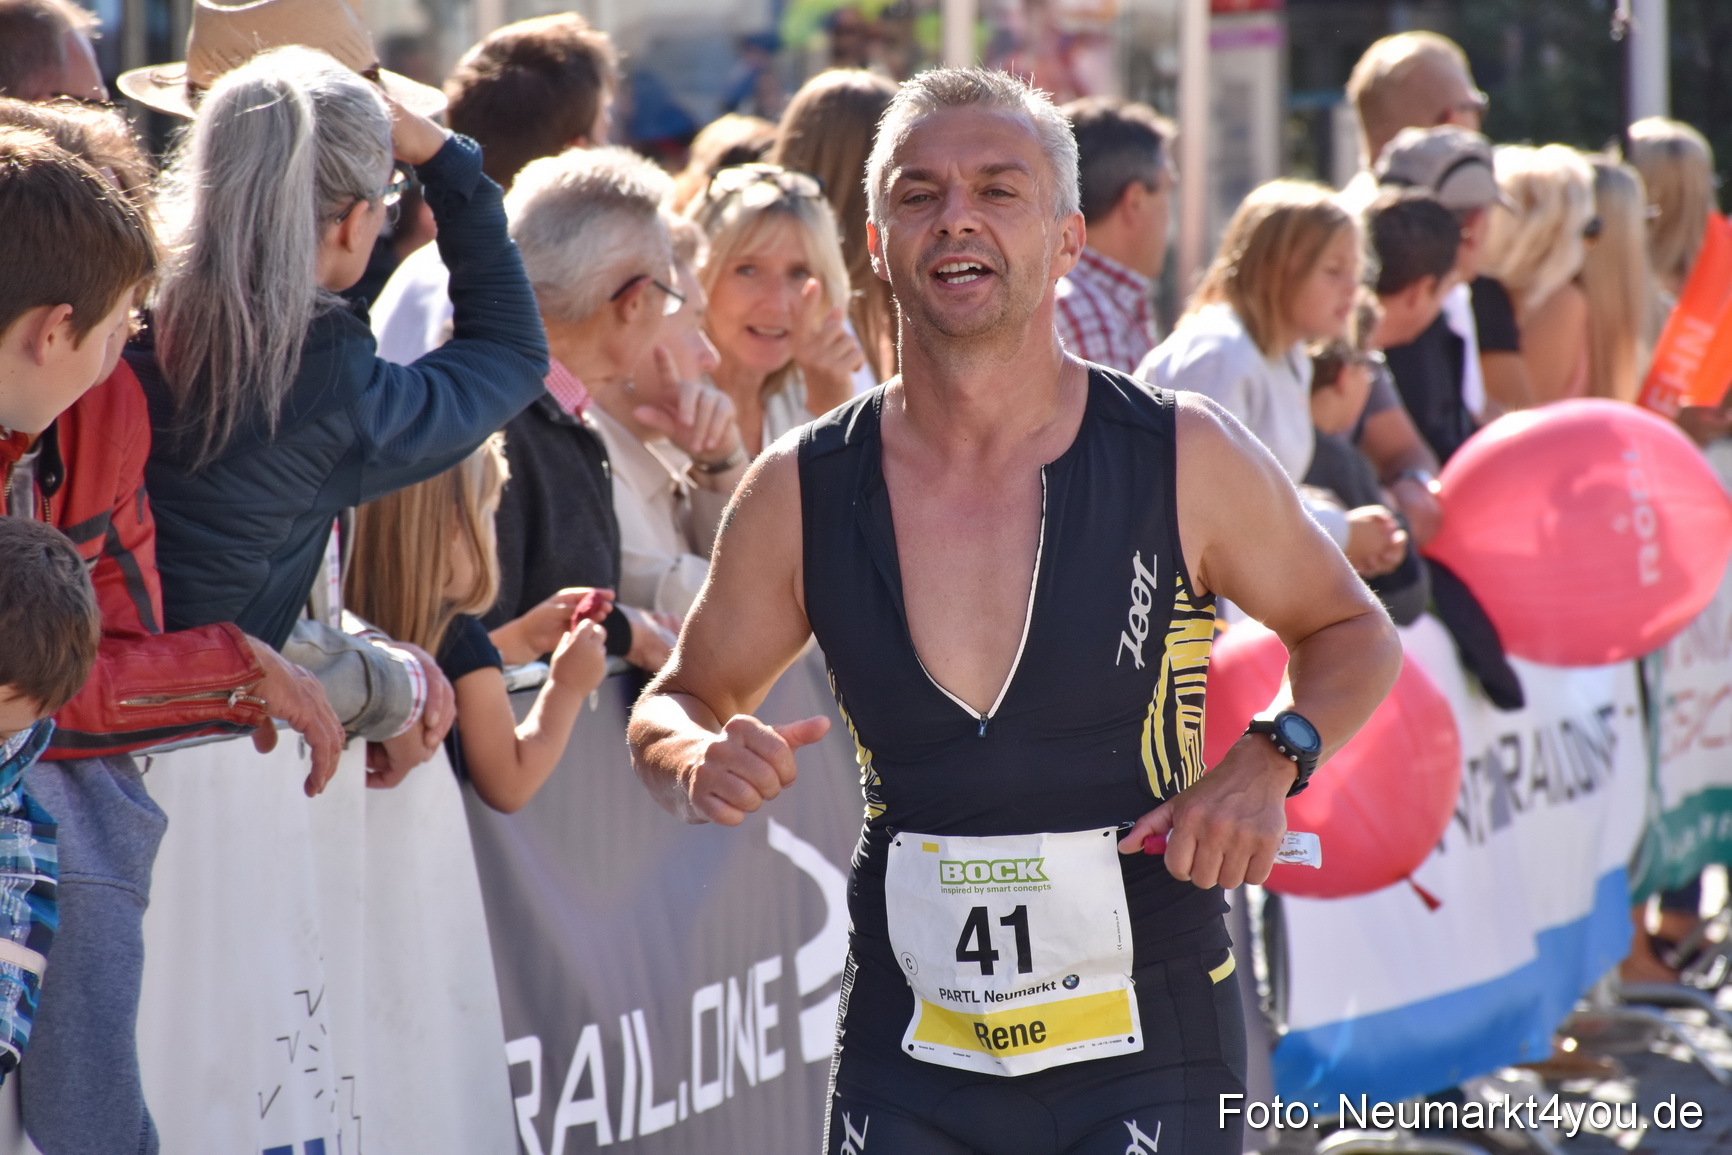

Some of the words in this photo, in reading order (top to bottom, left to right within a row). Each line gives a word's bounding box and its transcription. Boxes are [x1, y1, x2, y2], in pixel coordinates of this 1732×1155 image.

[940, 857, 1050, 885] BOCK
[941, 886, 972, 896] inspired
[974, 886, 985, 895] by
[987, 885, 1012, 893] smart
[1013, 884, 1052, 893] concepts
[956, 905, 1033, 975] 41
[939, 988, 981, 1003] PARTL
[984, 981, 1057, 1003] Neumarkt
[974, 1020, 1047, 1050] Rene
